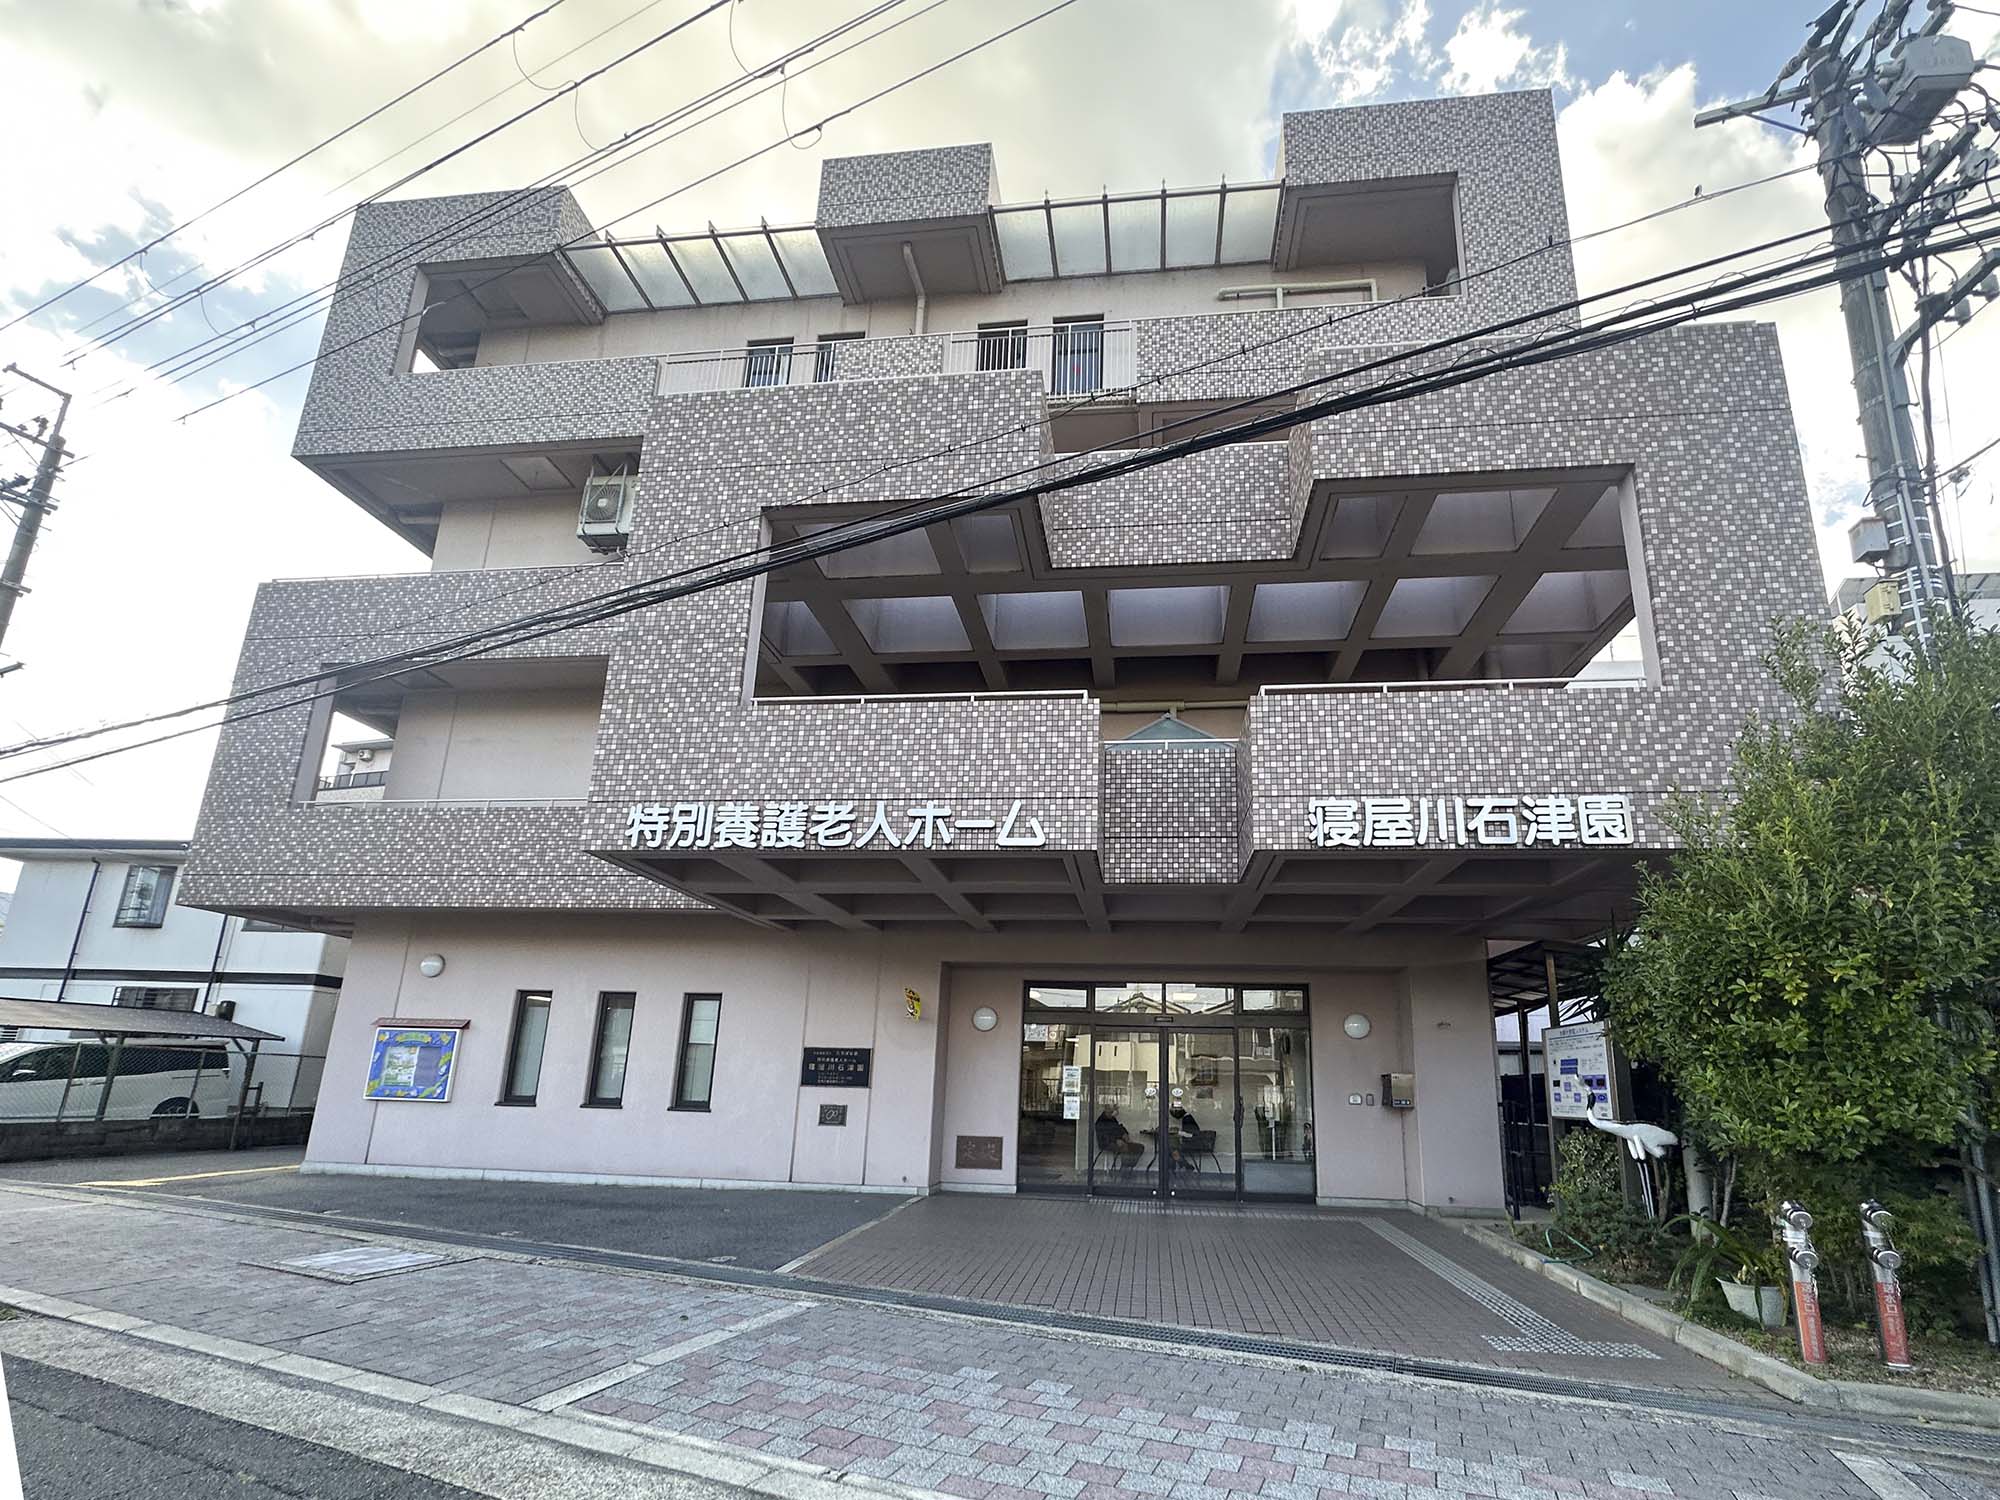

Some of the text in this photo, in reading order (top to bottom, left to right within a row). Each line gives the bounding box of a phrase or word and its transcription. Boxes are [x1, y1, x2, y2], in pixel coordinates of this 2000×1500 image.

[624, 799, 1046, 849] 特別養護老人ホーム
[1308, 795, 1634, 848] 寝屋川石津園
